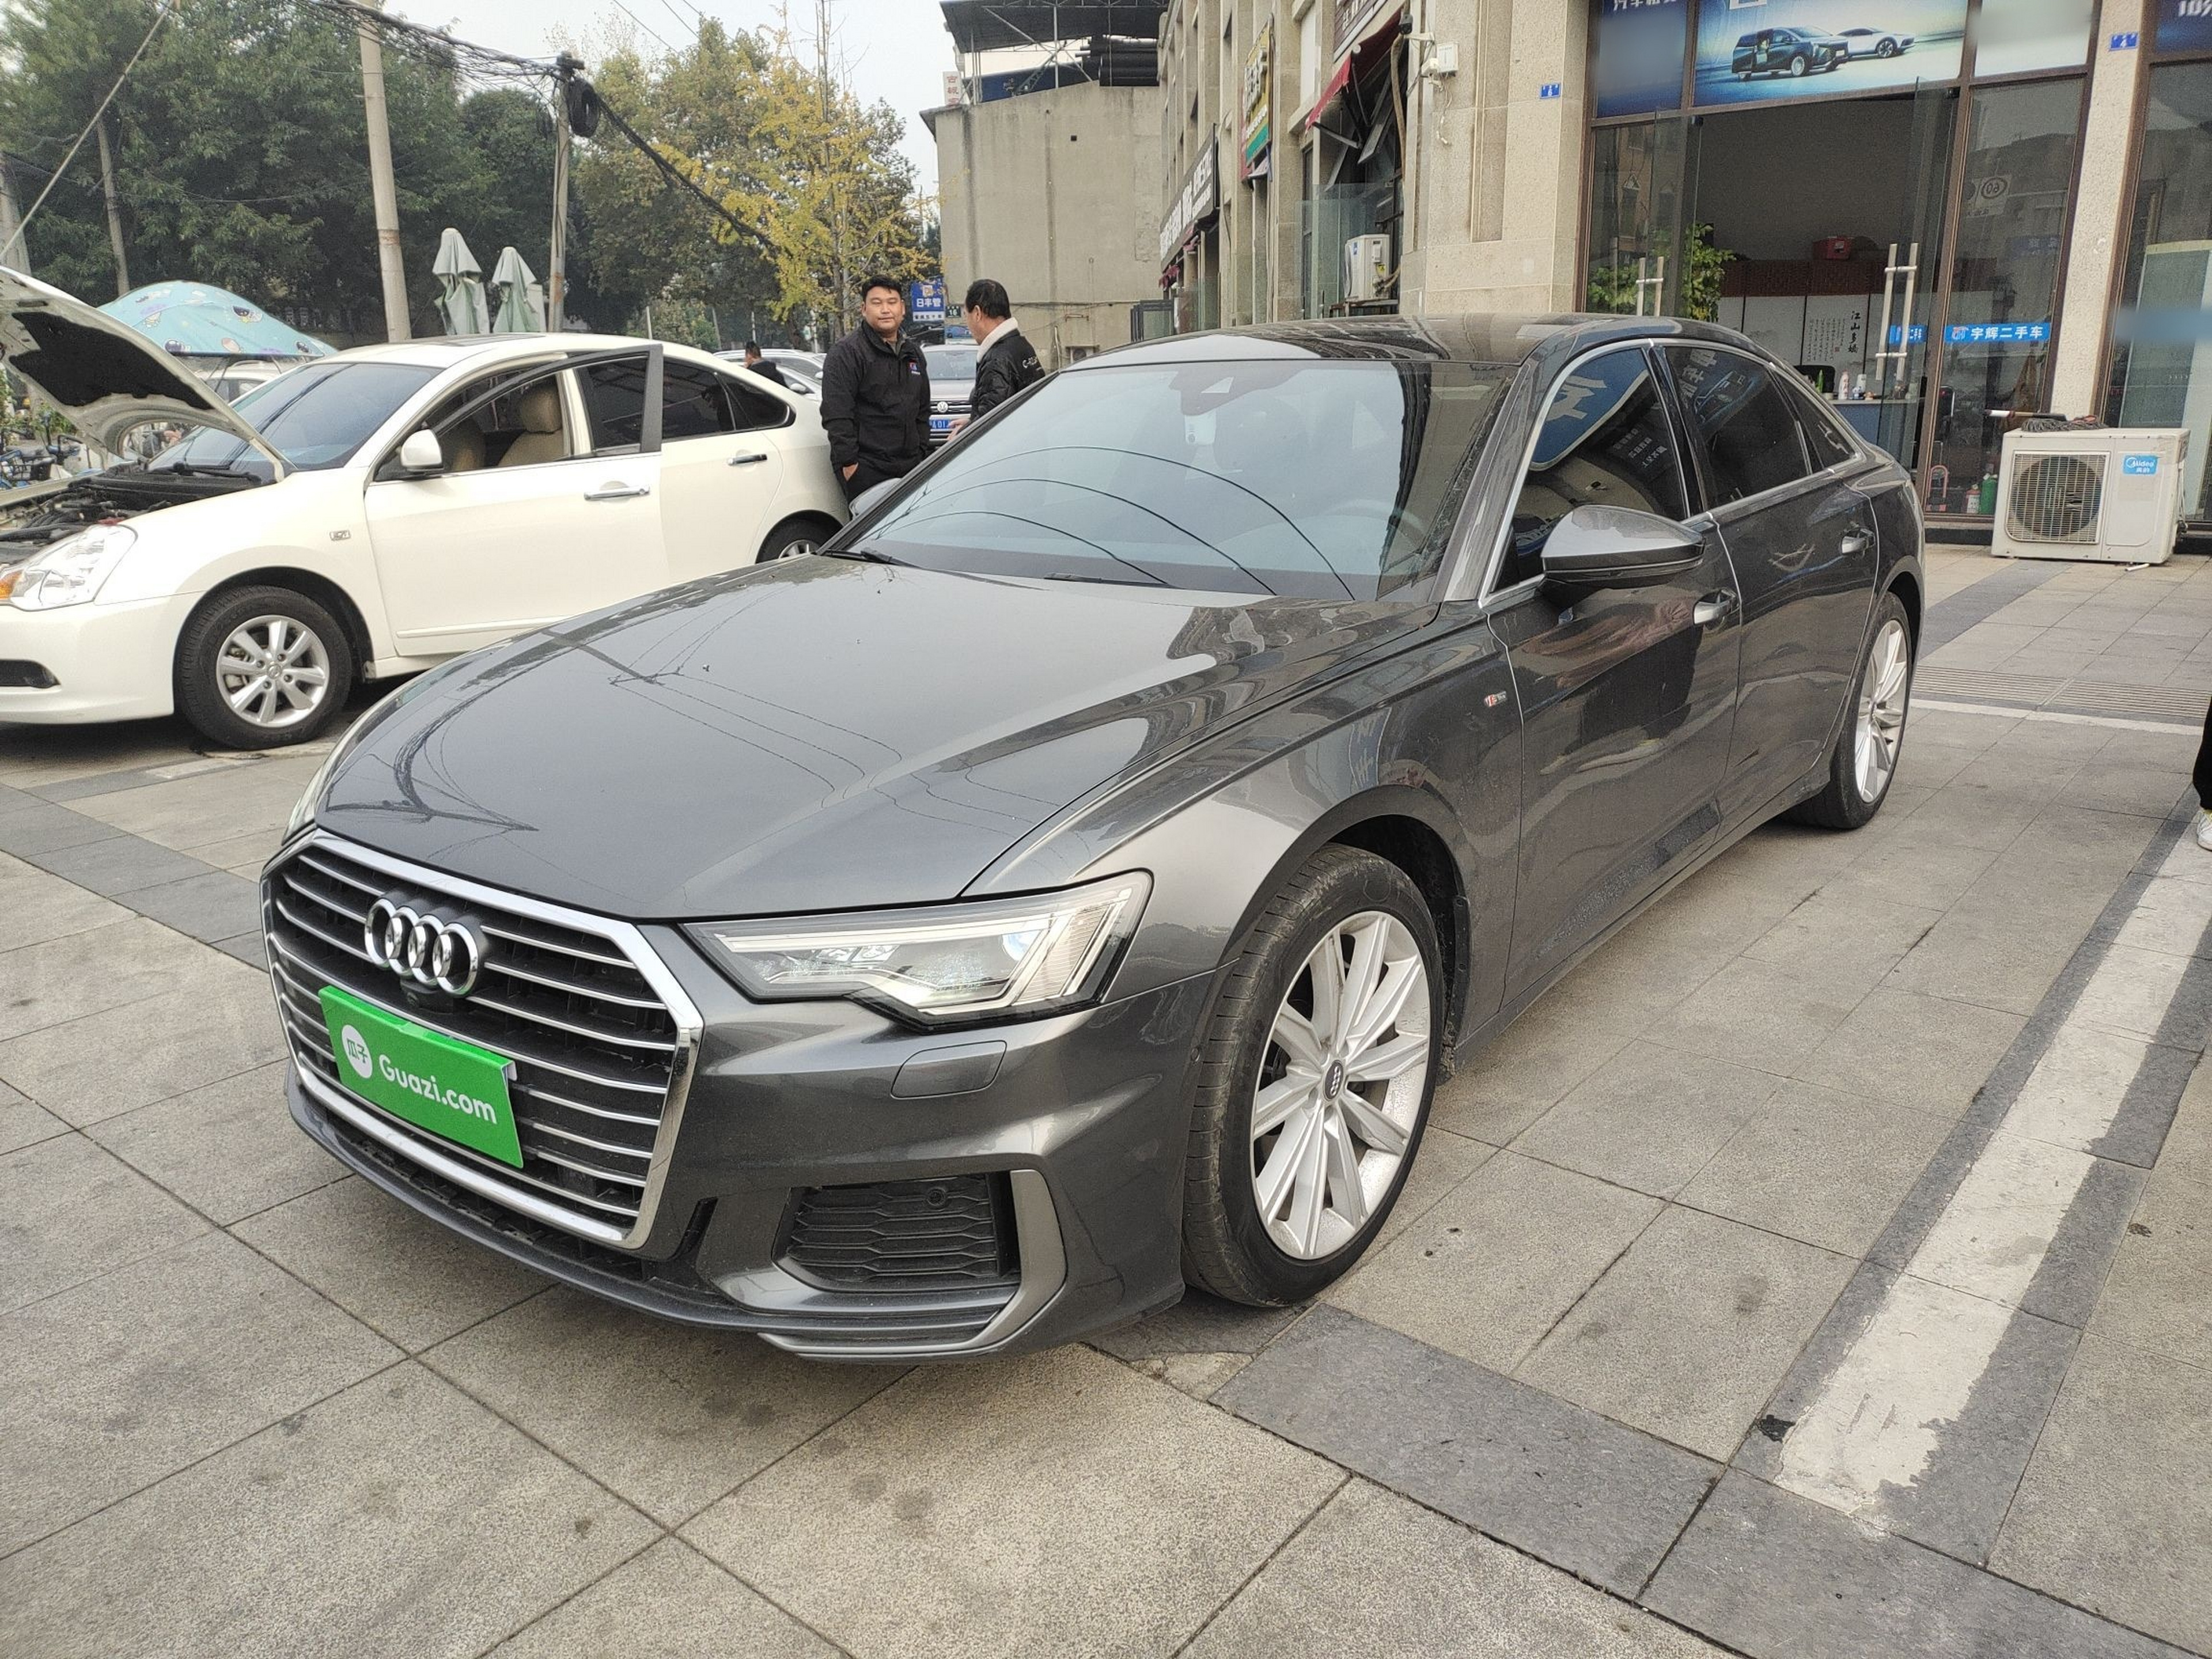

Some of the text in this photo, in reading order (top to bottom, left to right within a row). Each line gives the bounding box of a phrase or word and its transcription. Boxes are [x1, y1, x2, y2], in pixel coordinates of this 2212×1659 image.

[1971, 325, 2043, 340] 宇辉二手车
[346, 1037, 498, 1125] 瓜子 Guazi.com
